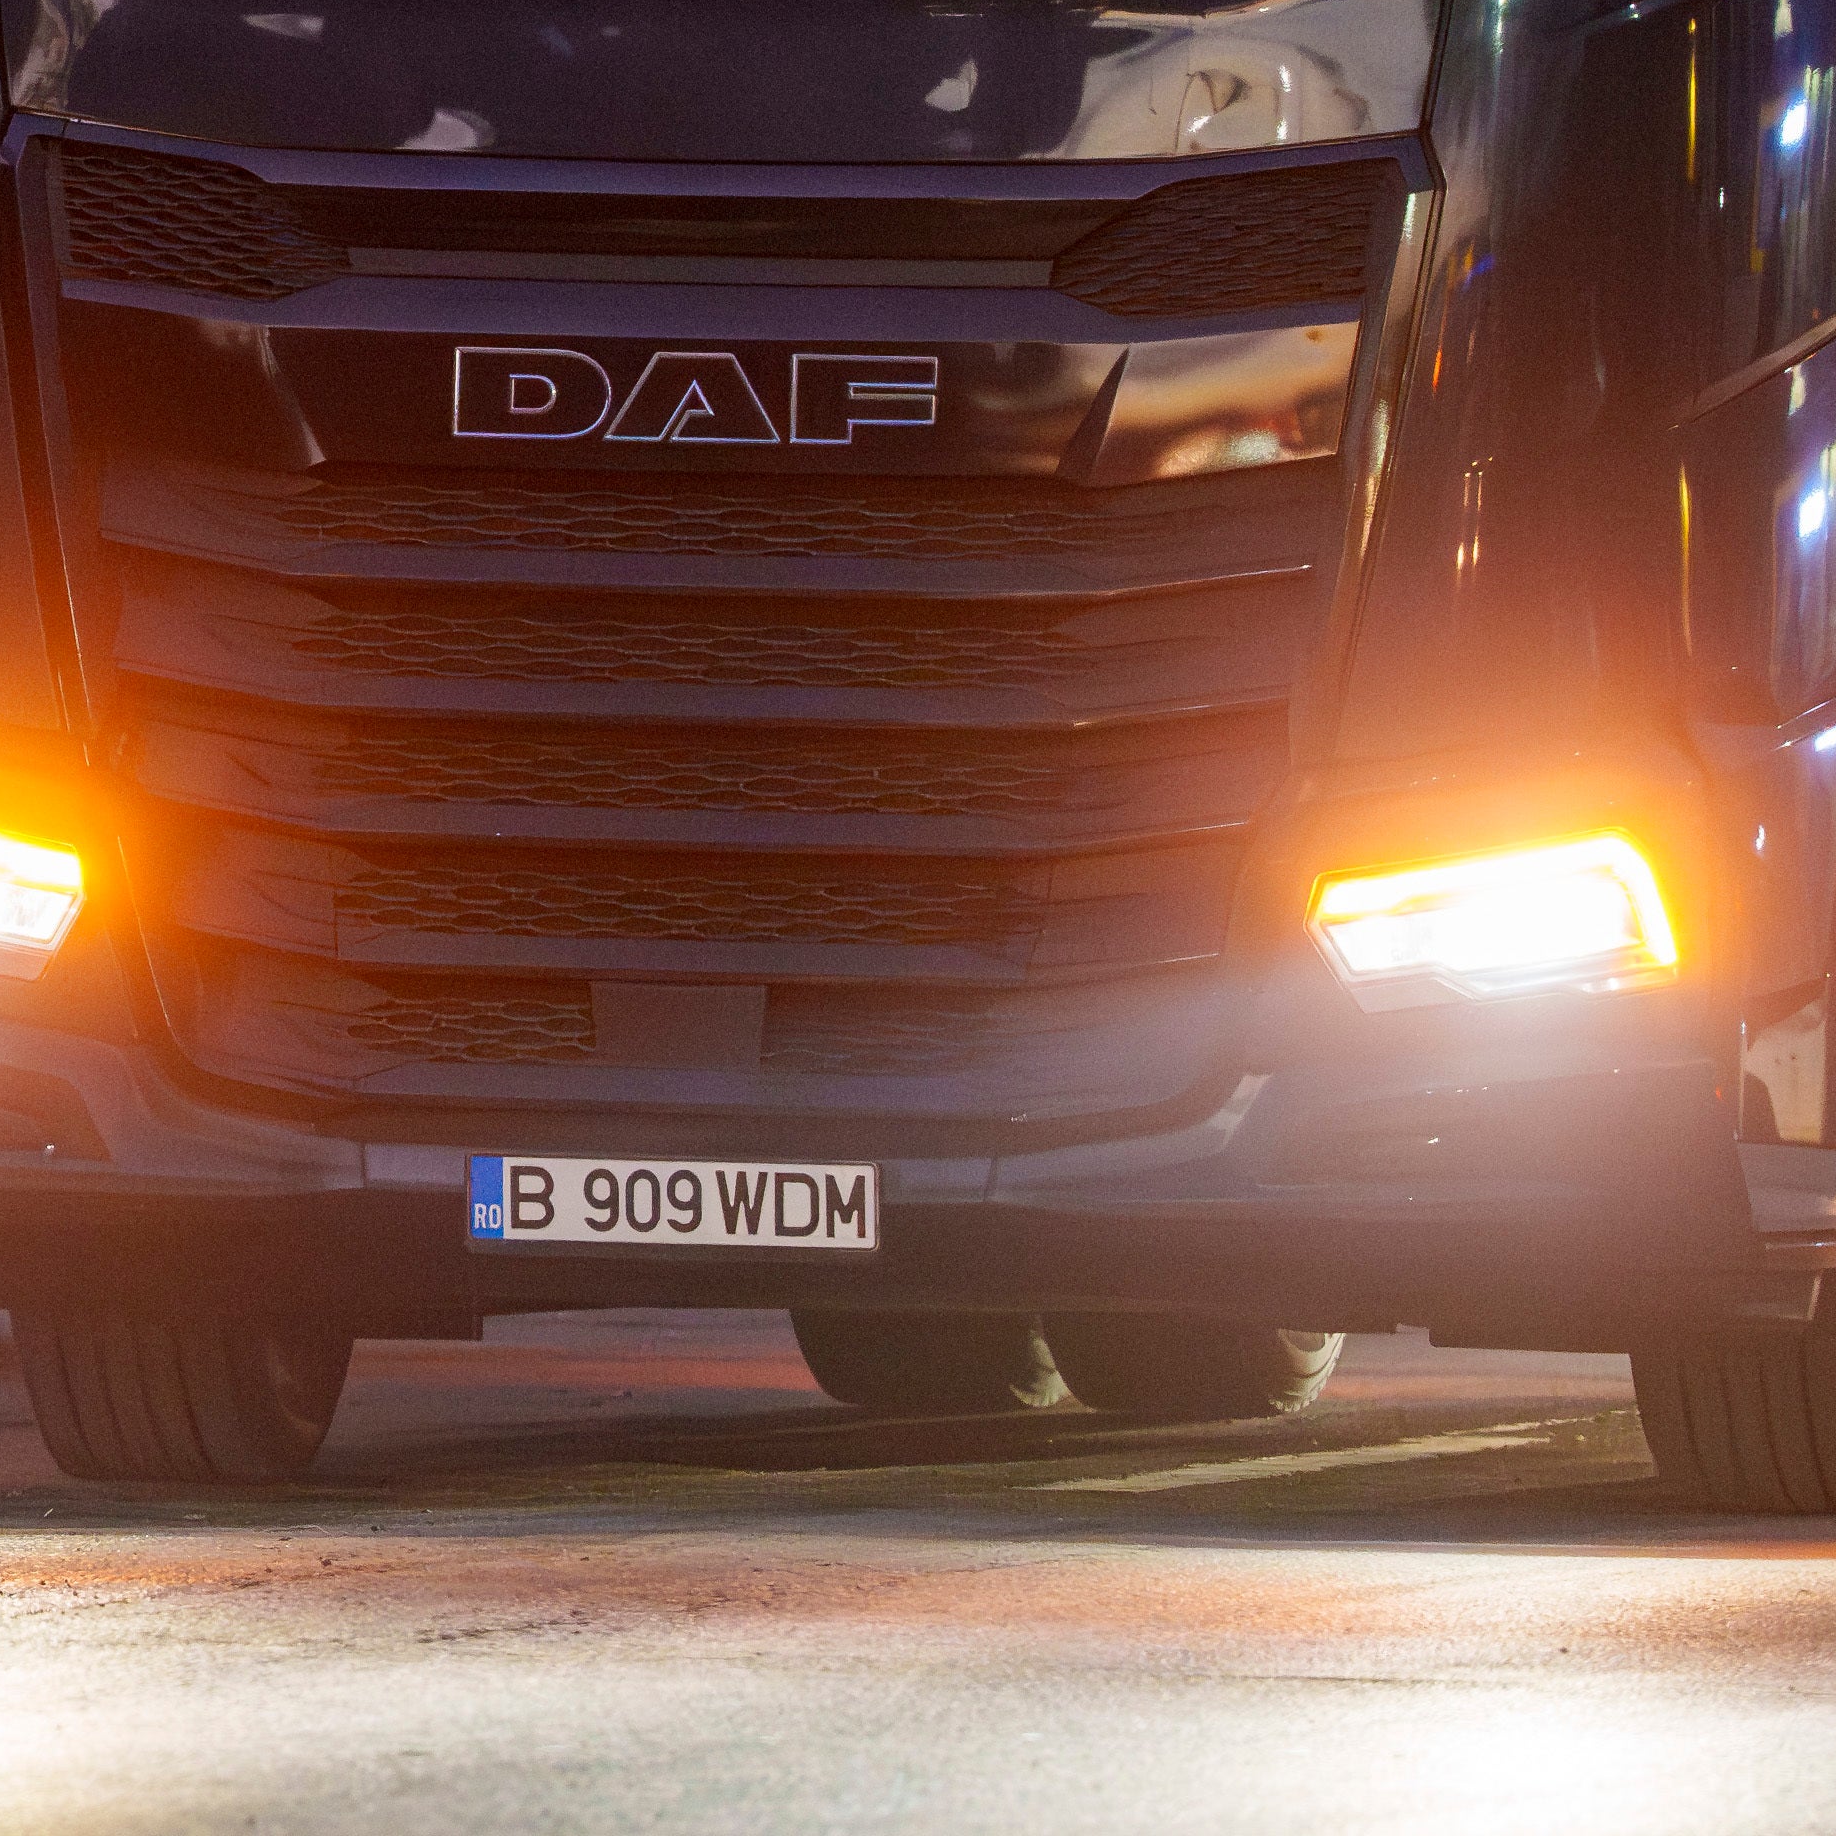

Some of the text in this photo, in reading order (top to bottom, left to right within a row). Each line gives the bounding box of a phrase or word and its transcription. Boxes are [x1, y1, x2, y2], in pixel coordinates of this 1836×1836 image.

[453, 347, 938, 446] DAF
[473, 1203, 502, 1231] RO
[510, 1165, 556, 1230] B
